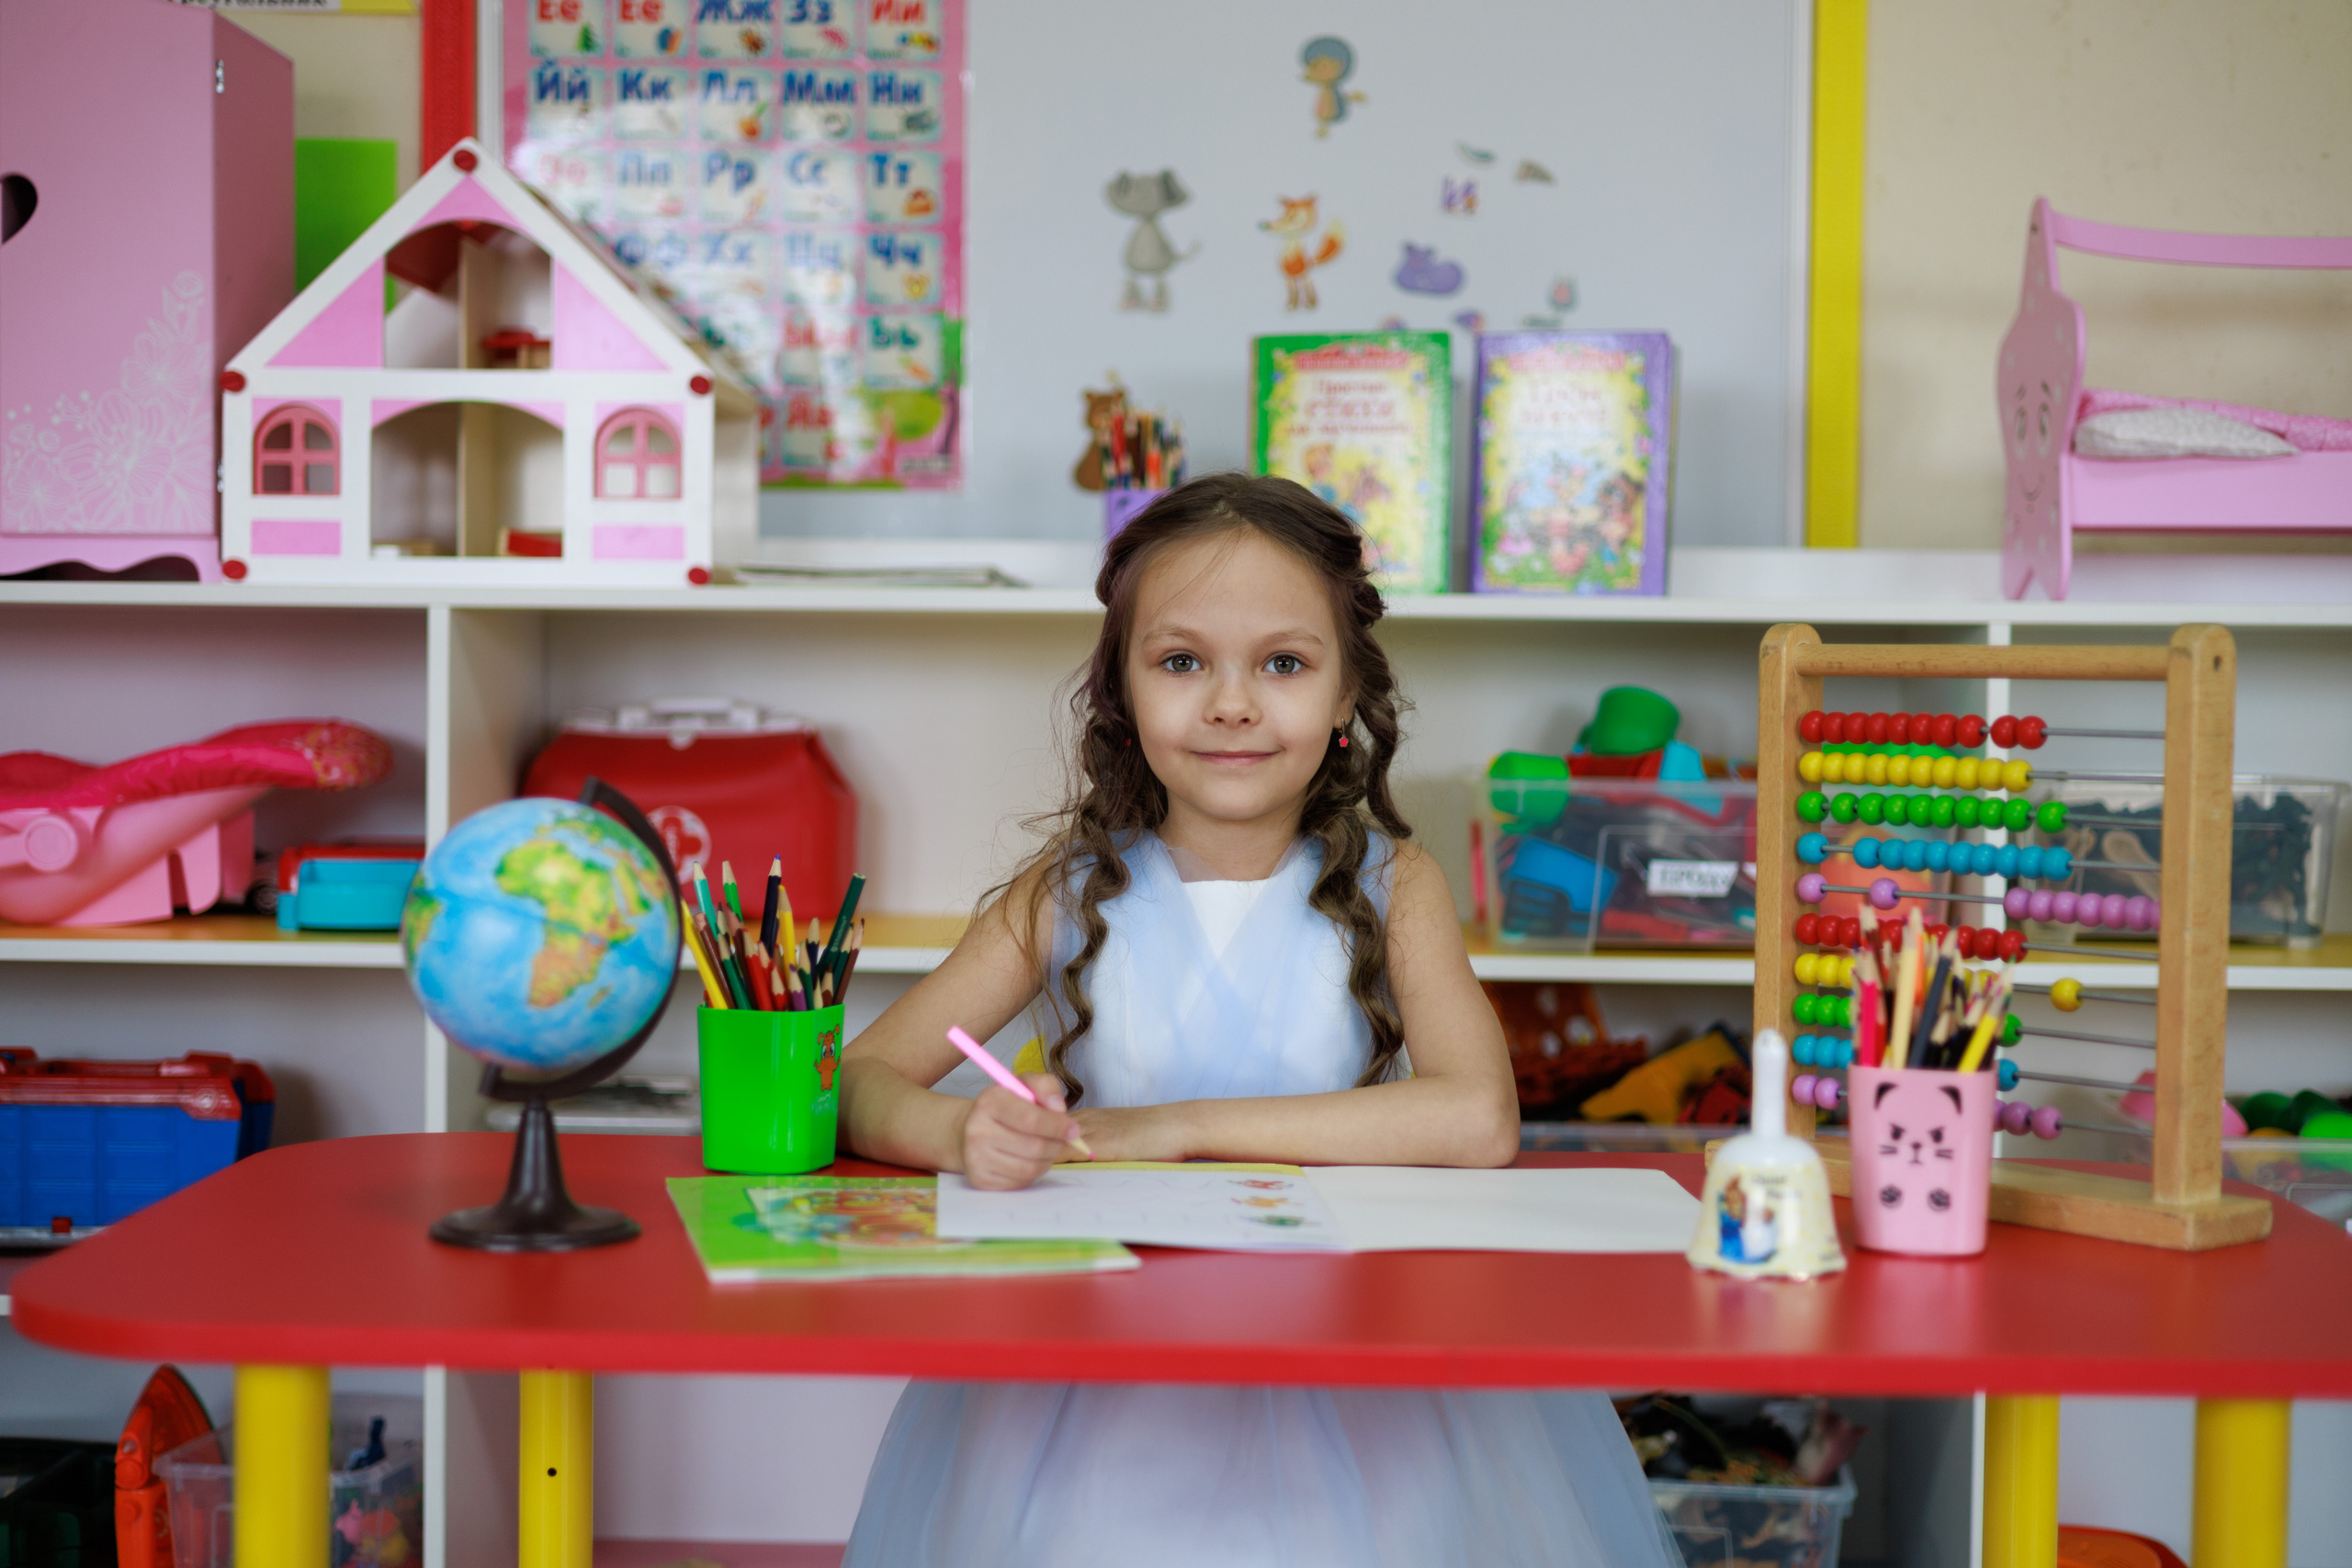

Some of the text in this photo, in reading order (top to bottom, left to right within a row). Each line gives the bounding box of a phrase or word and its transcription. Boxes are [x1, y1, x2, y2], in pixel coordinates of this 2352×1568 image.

[536, 57, 590, 103] Йй
[622, 69, 672, 102] Кк
[783, 71, 855, 104] Мм
[873, 71, 923, 104] Нн
[707, 151, 754, 190] Рр
[870, 152, 911, 186] Тт
[870, 233, 922, 265] Чч
